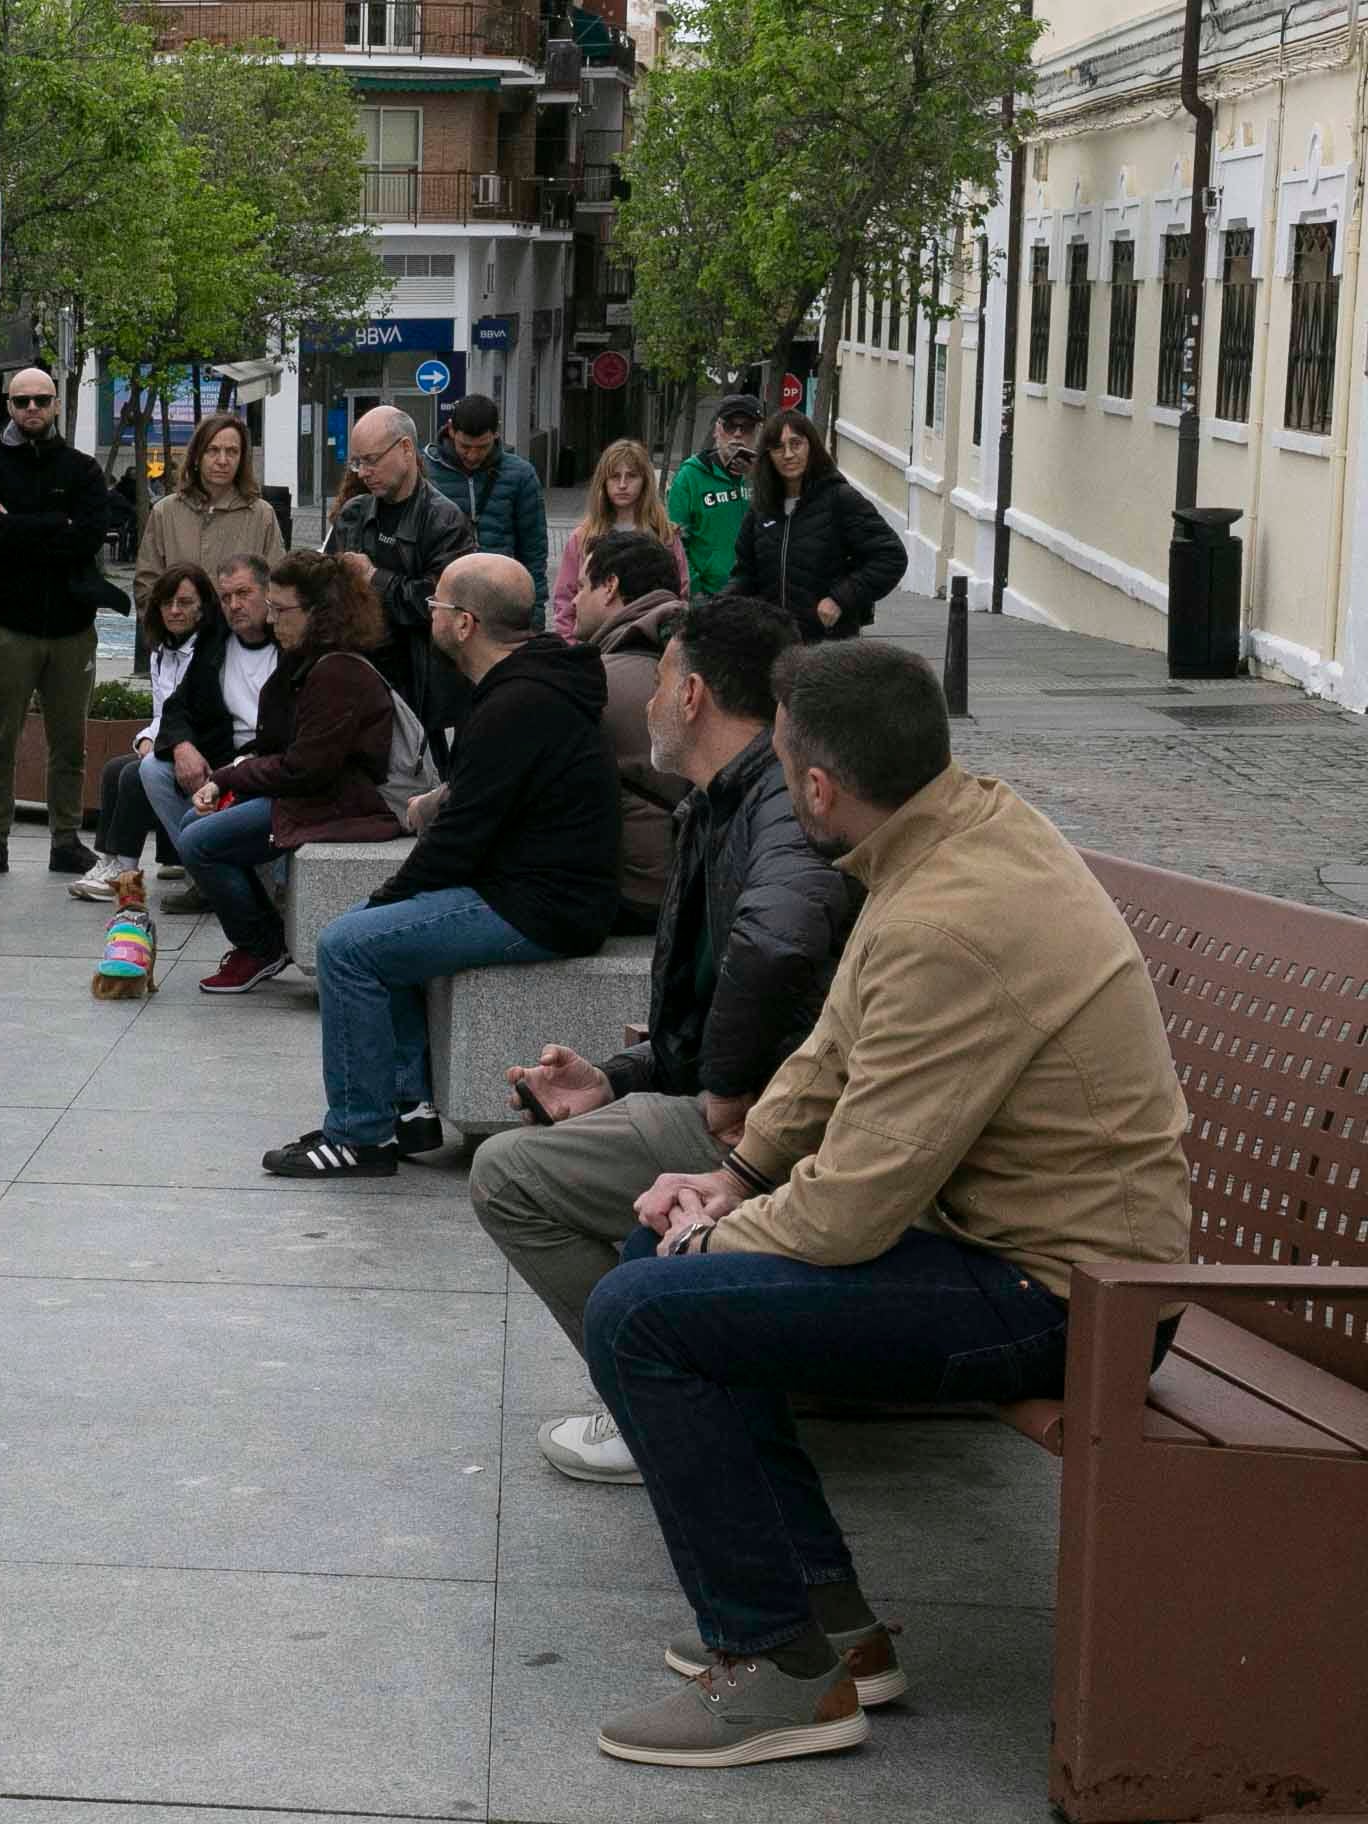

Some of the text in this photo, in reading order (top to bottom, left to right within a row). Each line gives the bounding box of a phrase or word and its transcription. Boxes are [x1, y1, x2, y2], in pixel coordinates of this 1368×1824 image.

[355, 325, 403, 346] BBVA
[480, 329, 507, 339] BBVA
[784, 387, 799, 397] OP
